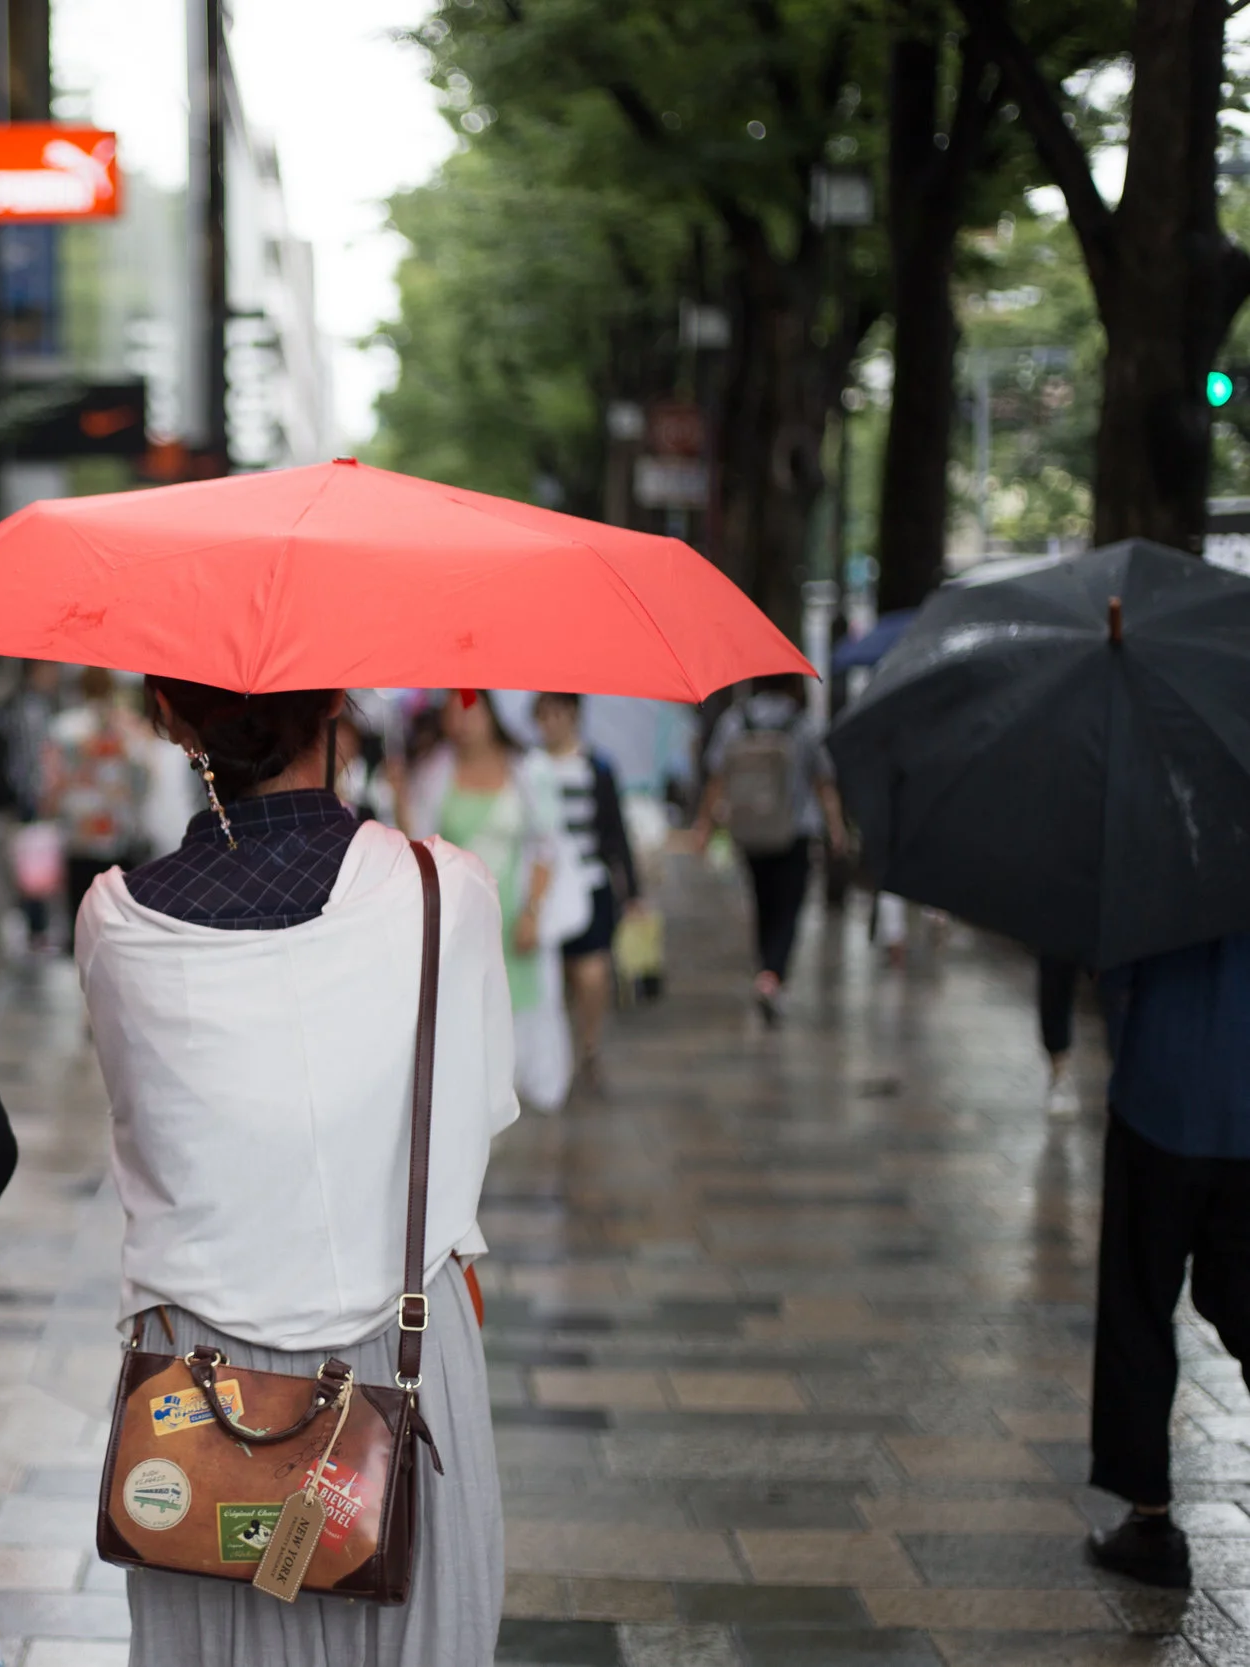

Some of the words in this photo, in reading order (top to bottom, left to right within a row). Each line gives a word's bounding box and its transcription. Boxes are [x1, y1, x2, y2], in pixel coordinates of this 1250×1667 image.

[319, 1487, 359, 1518] BIEVRE
[324, 1505, 350, 1529] OTEL
[293, 1517, 310, 1549] NEW
[276, 1550, 298, 1584] YORK
